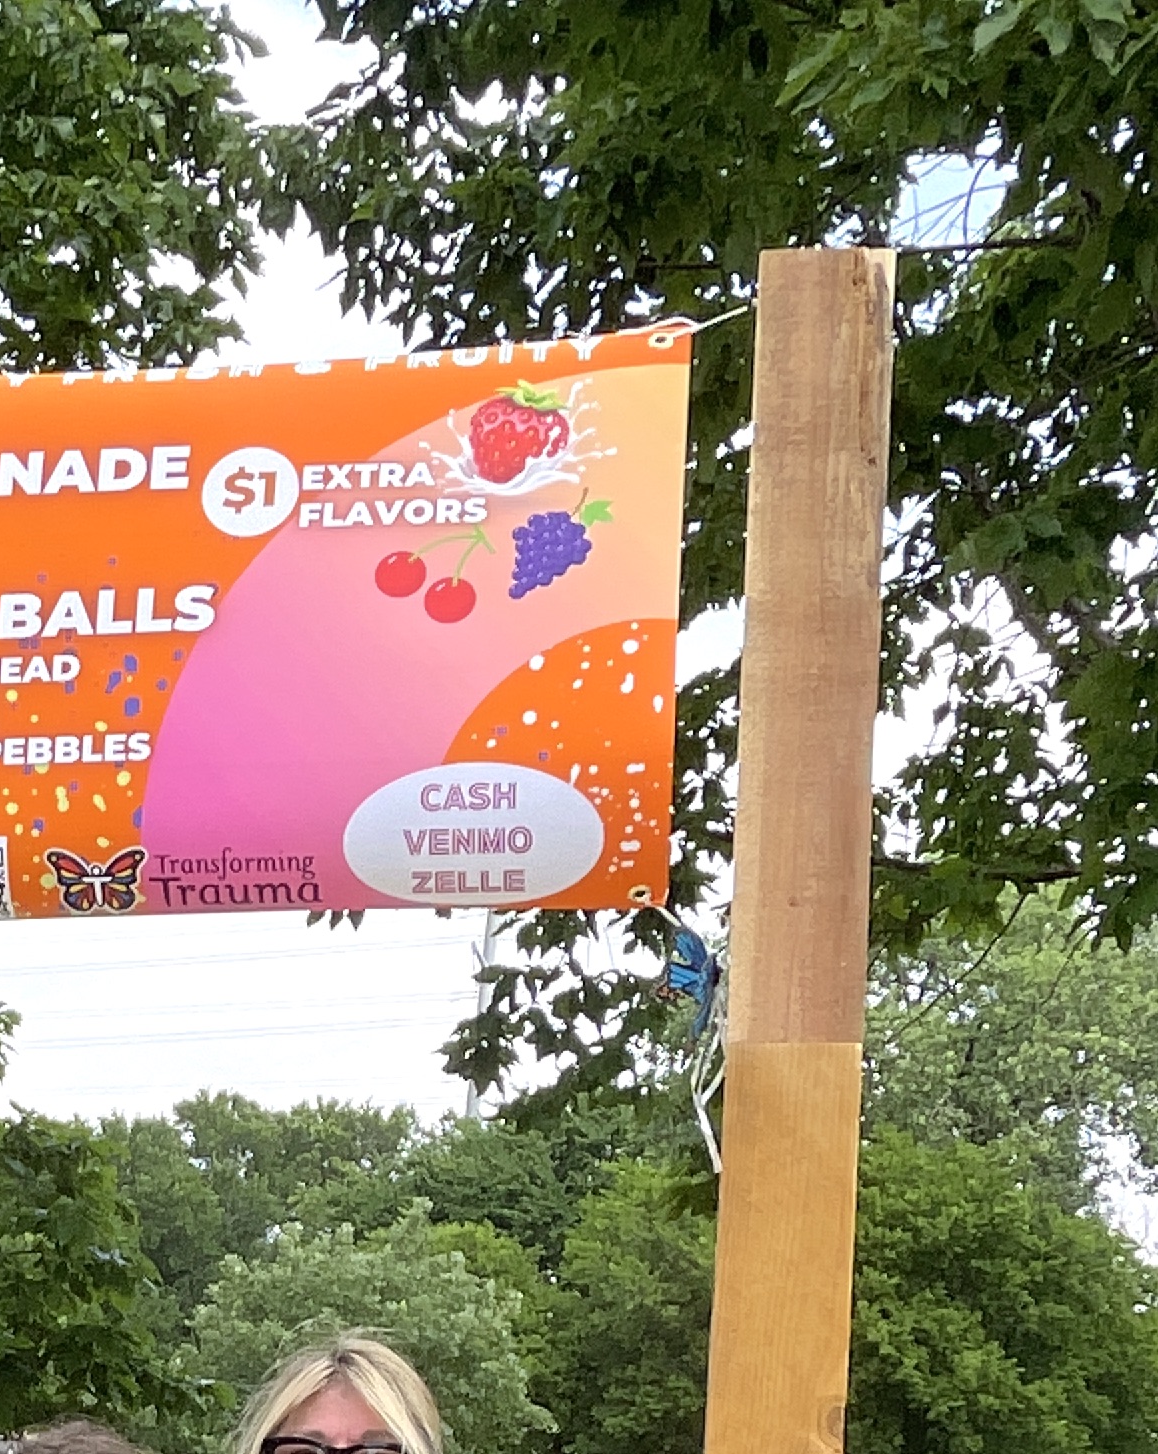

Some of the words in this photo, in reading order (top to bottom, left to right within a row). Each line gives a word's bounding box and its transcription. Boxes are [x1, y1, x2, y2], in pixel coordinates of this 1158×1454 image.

[221, 465, 278, 515] $1
[300, 461, 435, 491] EXTRA
[298, 497, 487, 528] FLAVORS
[420, 781, 517, 812] CASH
[402, 826, 533, 856] VENMO
[154, 847, 315, 881] Transforming
[149, 876, 323, 907] Trauma
[411, 868, 526, 894] ZELLE
